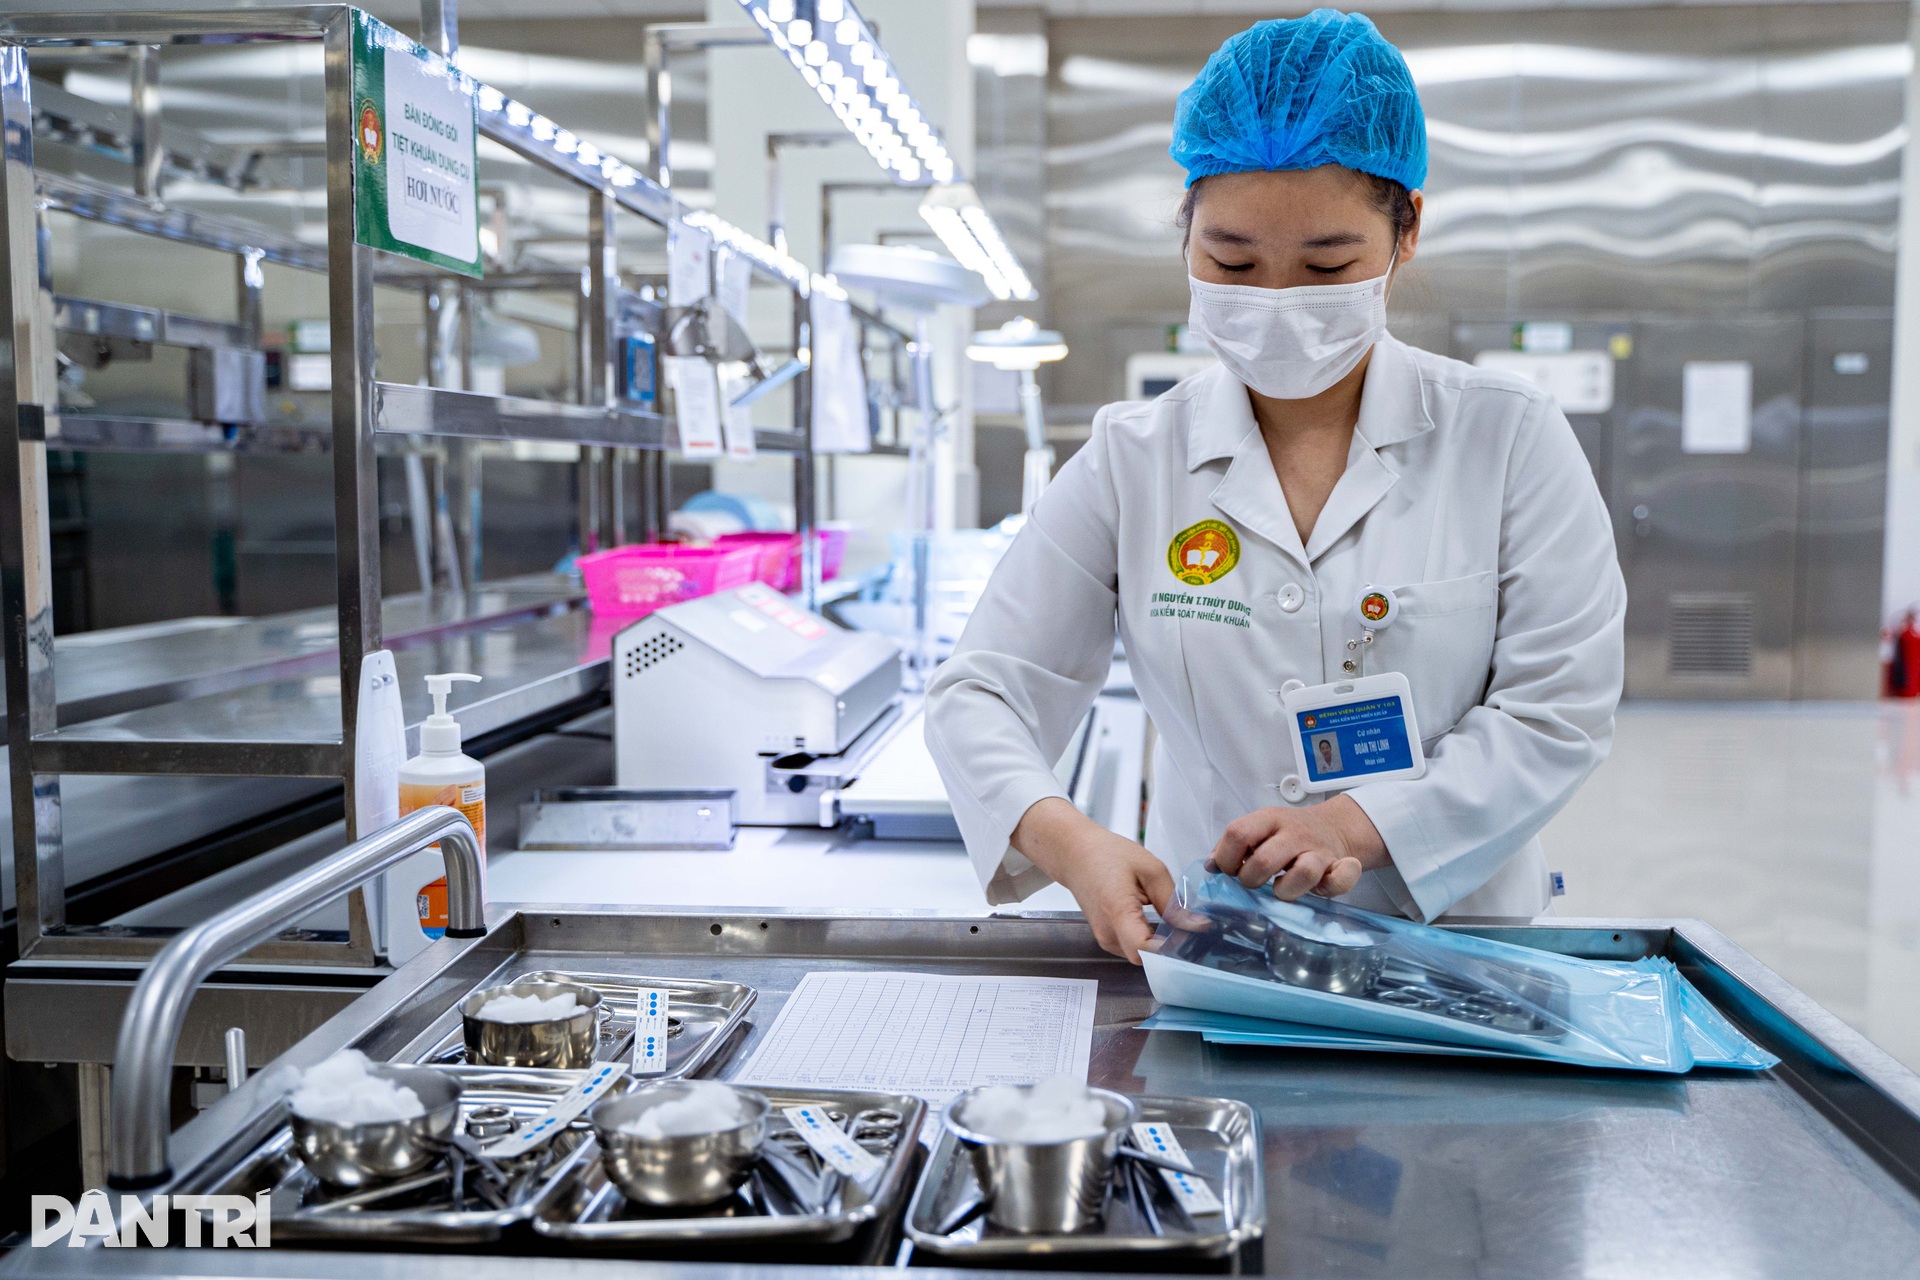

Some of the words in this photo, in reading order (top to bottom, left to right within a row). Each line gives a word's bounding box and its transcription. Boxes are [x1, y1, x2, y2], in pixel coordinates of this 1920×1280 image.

[404, 102, 421, 125] BÀN
[422, 110, 444, 136] ĐÓNG
[445, 123, 459, 143] GÓI
[406, 176, 428, 203] HƠI
[429, 185, 460, 214] NƯỚC
